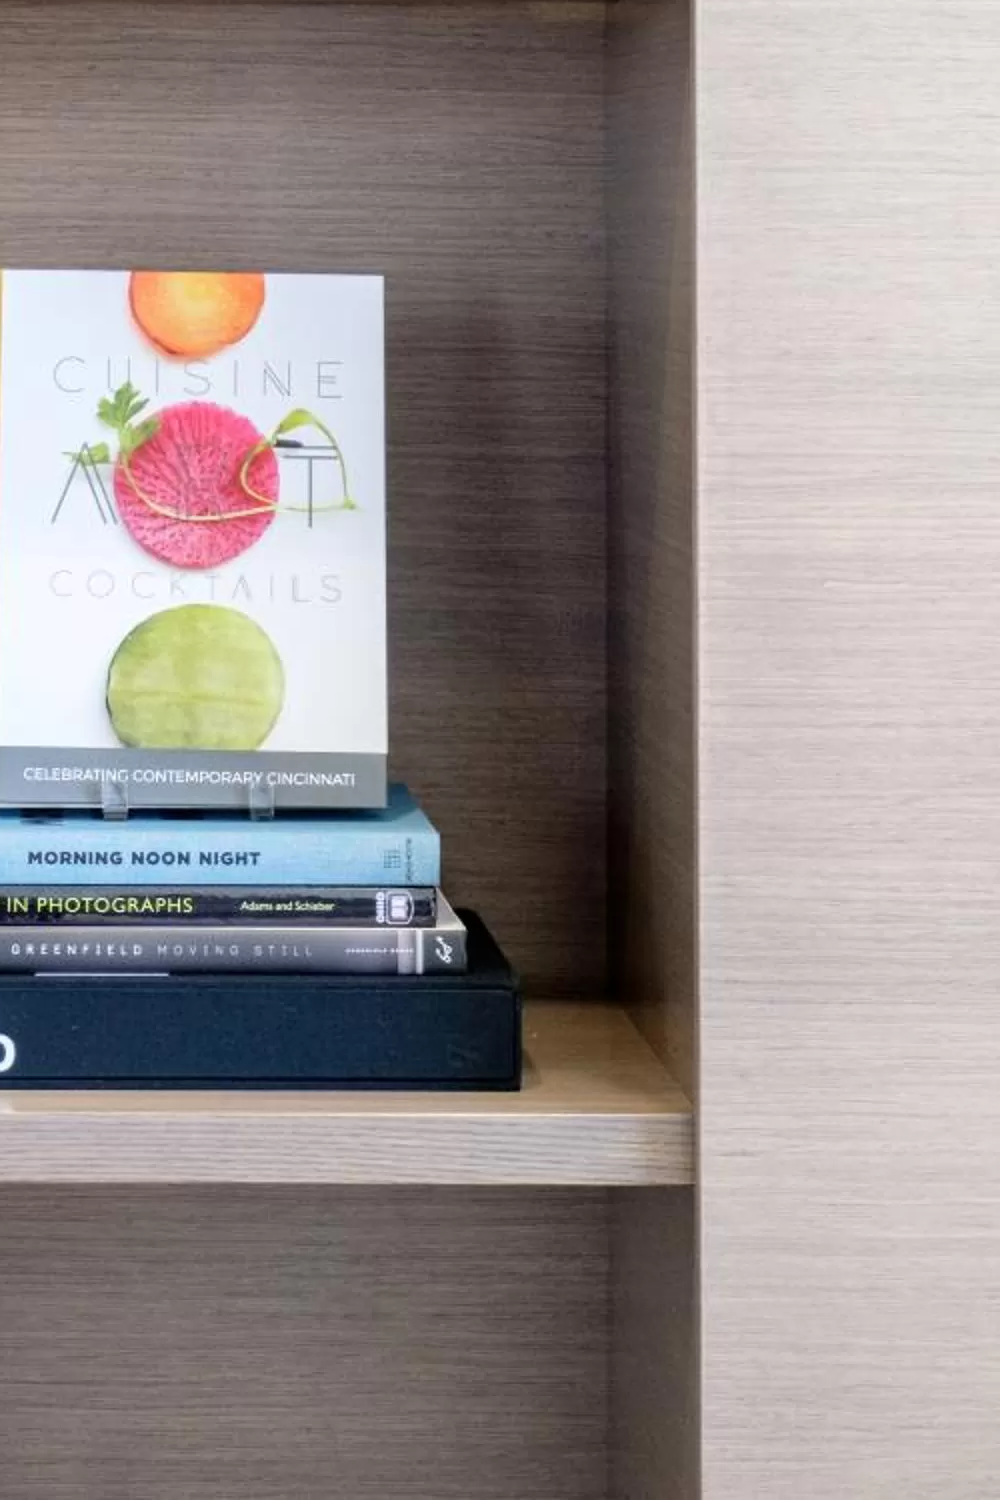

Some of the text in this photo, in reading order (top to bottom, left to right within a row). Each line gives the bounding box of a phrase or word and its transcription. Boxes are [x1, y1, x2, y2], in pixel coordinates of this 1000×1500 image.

[52, 355, 345, 399] CUISINE
[50, 440, 340, 529] AT
[48, 568, 343, 604] COCKTAILS
[23, 767, 356, 787] CELEBRATING CONTEMPORARY CINCINNATI
[27, 851, 261, 866] MORNING NOON NIGHT
[6, 897, 29, 913] IN
[36, 897, 193, 914] PHOTOGRAPHS
[240, 901, 273, 911] Adams
[275, 901, 293, 911] and
[10, 942, 145, 956] GREENFIELD
[157, 943, 241, 956] MOVING
[254, 944, 314, 957] STILL
